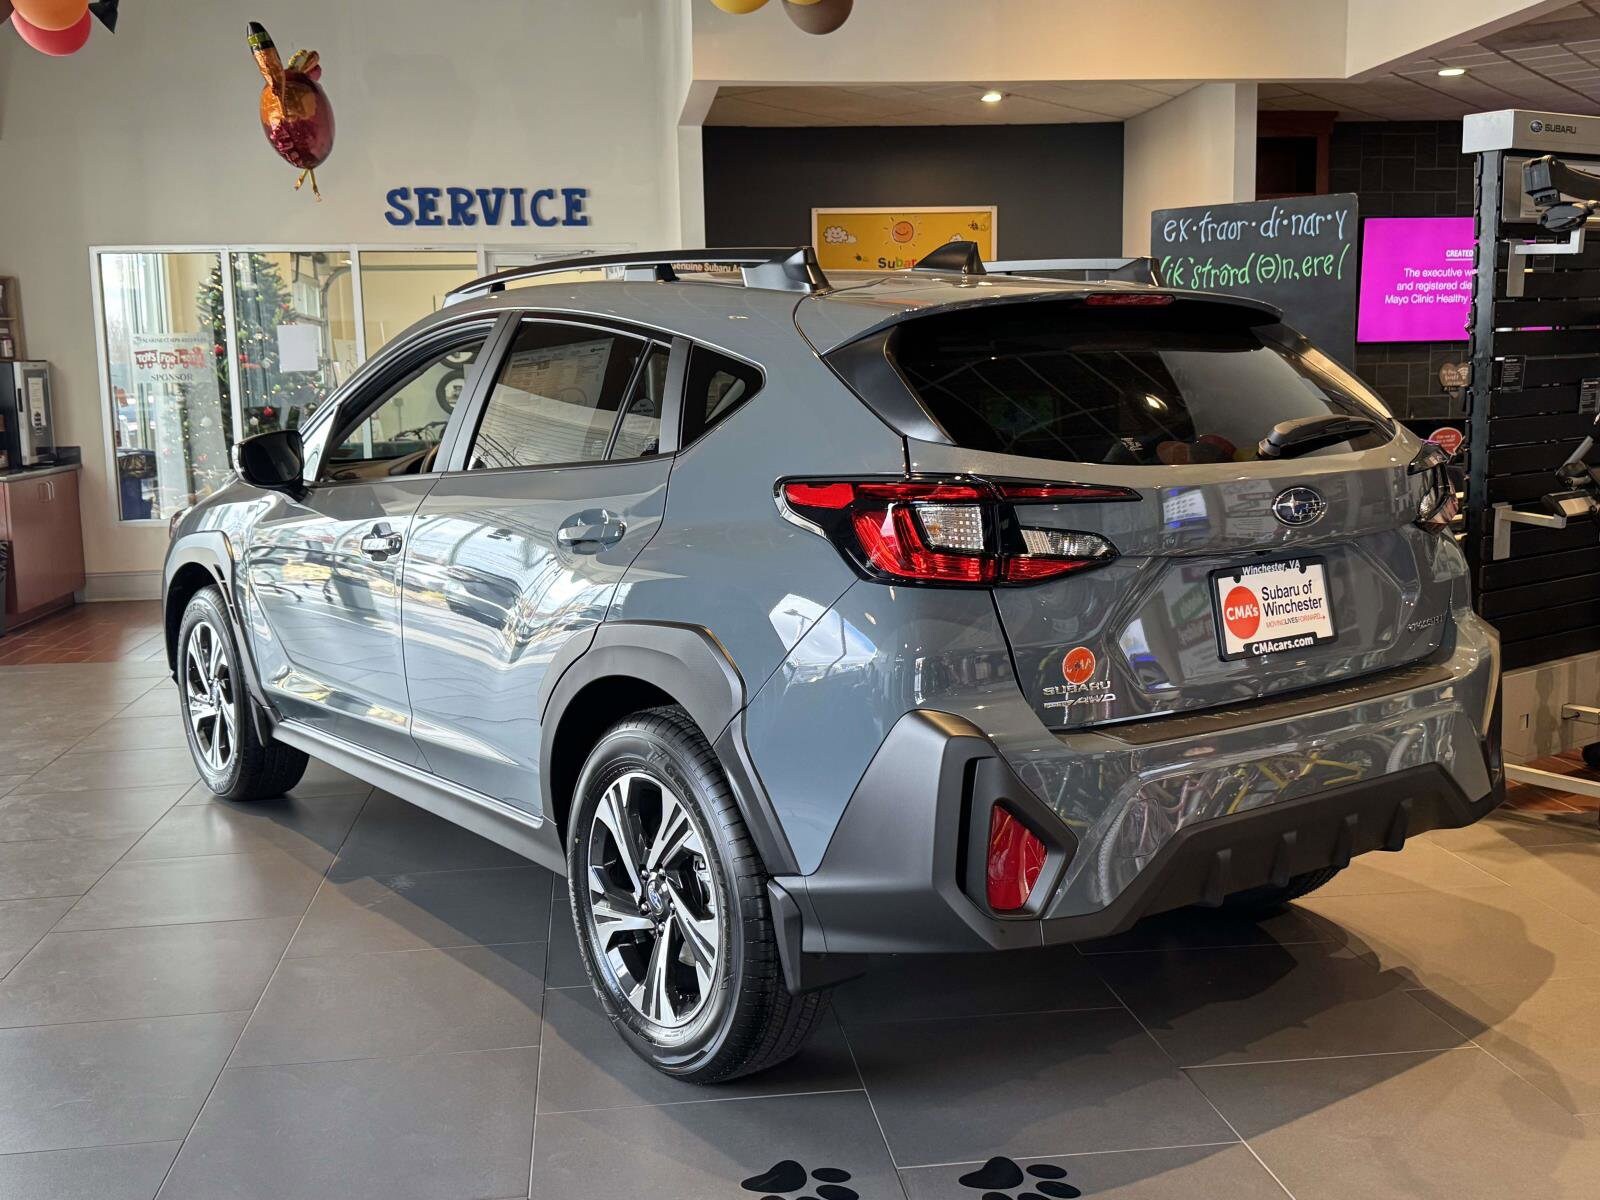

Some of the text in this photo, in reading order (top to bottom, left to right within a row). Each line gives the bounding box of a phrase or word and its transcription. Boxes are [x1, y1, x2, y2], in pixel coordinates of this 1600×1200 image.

[1544, 123, 1577, 135] SUBARU
[384, 187, 589, 227] SERVICE
[1445, 249, 1474, 258] CREATED
[703, 263, 732, 273] Subaru
[1404, 267, 1420, 278] The
[1422, 267, 1462, 278] executive
[1396, 281, 1413, 291] and
[1415, 281, 1457, 293] registered
[1384, 293, 1468, 306] Mayo Clinic Healthy
[136, 352, 156, 363] TOYS
[150, 373, 193, 381] SPONSOR
[1242, 559, 1301, 576] Winchester, VA
[1261, 579, 1313, 601] Subaru of
[1226, 603, 1260, 621] CMA's
[1262, 596, 1323, 617] Winchester
[1252, 636, 1314, 655] CMAcars.com
[1042, 680, 1111, 696] SUBARU
